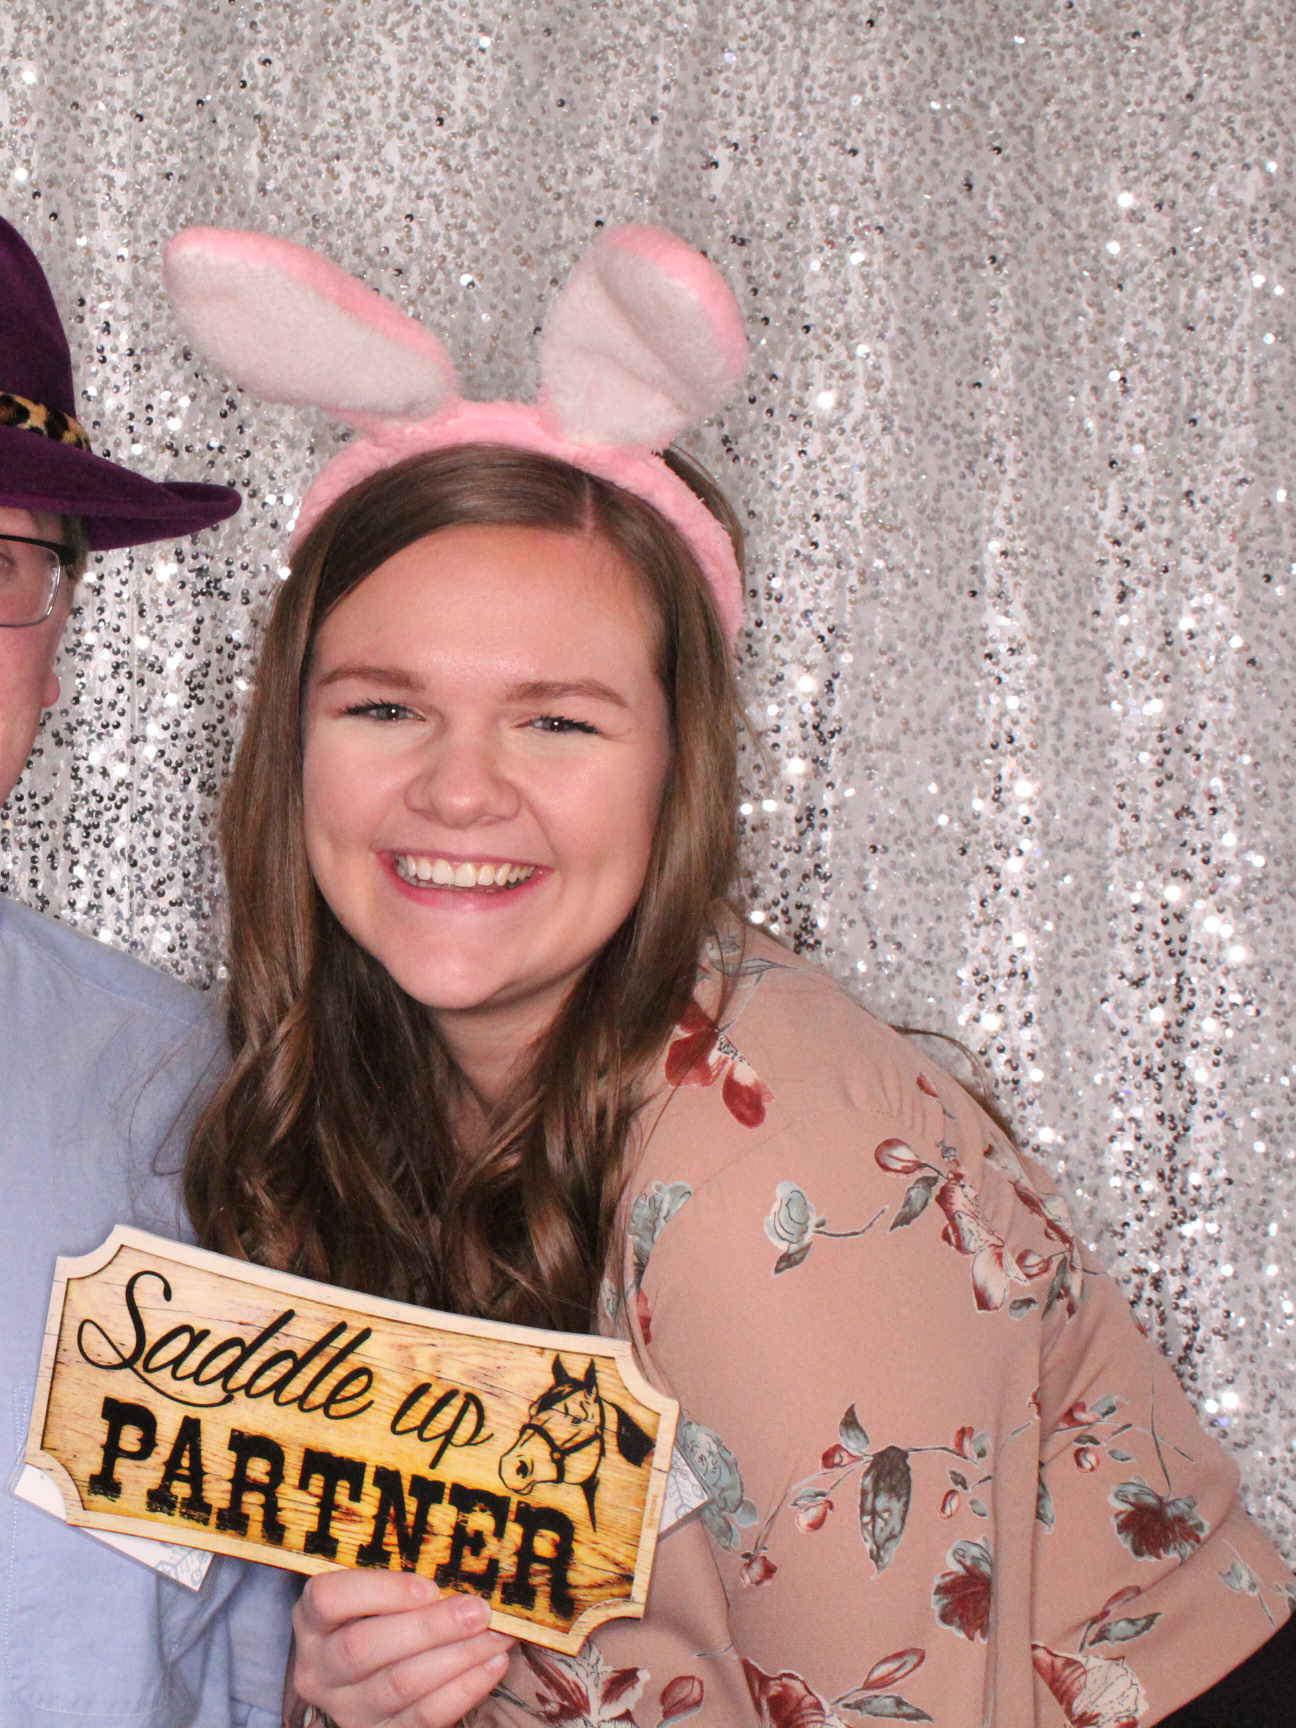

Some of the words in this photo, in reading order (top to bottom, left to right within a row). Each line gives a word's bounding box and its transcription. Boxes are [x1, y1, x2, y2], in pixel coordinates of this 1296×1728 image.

[78, 1270, 376, 1421] Saddle
[390, 1381, 493, 1470] up
[86, 1396, 577, 1621] PARTNER
